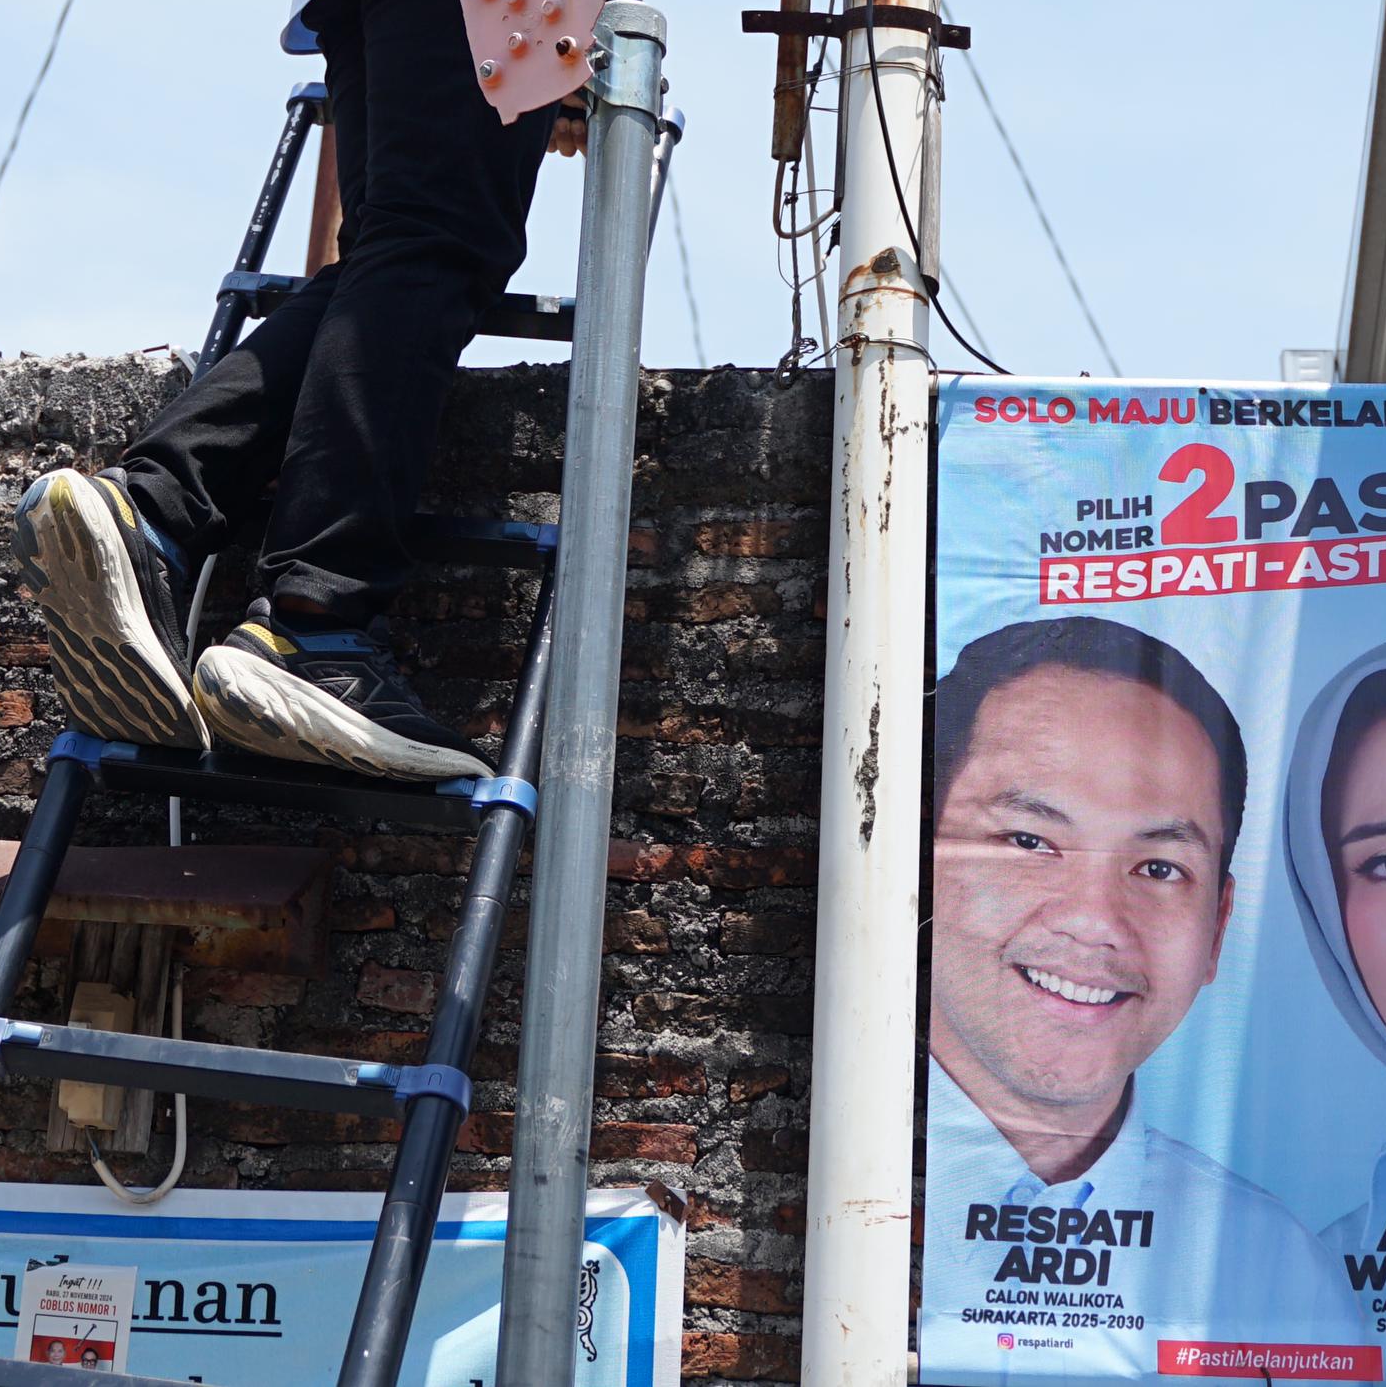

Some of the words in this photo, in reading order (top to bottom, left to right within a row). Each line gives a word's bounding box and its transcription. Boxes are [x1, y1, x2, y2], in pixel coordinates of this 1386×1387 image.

[974, 396, 1076, 424] SOLO
[1088, 397, 1196, 425] MAJU
[1158, 443, 1238, 545] 2
[1077, 495, 1153, 521] PILIH
[1040, 525, 1154, 554] NOMER
[965, 1204, 1154, 1247] RESPATI
[993, 1245, 1111, 1286] ARDI
[40, 1298, 74, 1312] COBLOS
[77, 1301, 110, 1315] NOMOR
[70, 1292, 98, 1301] NOVEMBER
[986, 1289, 1039, 1305] CALON
[1044, 1291, 1124, 1309] WALIKOTA
[961, 1308, 1057, 1327] SURAKARTA
[1062, 1312, 1145, 1330] 2025-2030
[1018, 1337, 1073, 1349] respatiardi
[1176, 1348, 1354, 1373] #PastiMelanjutkan
